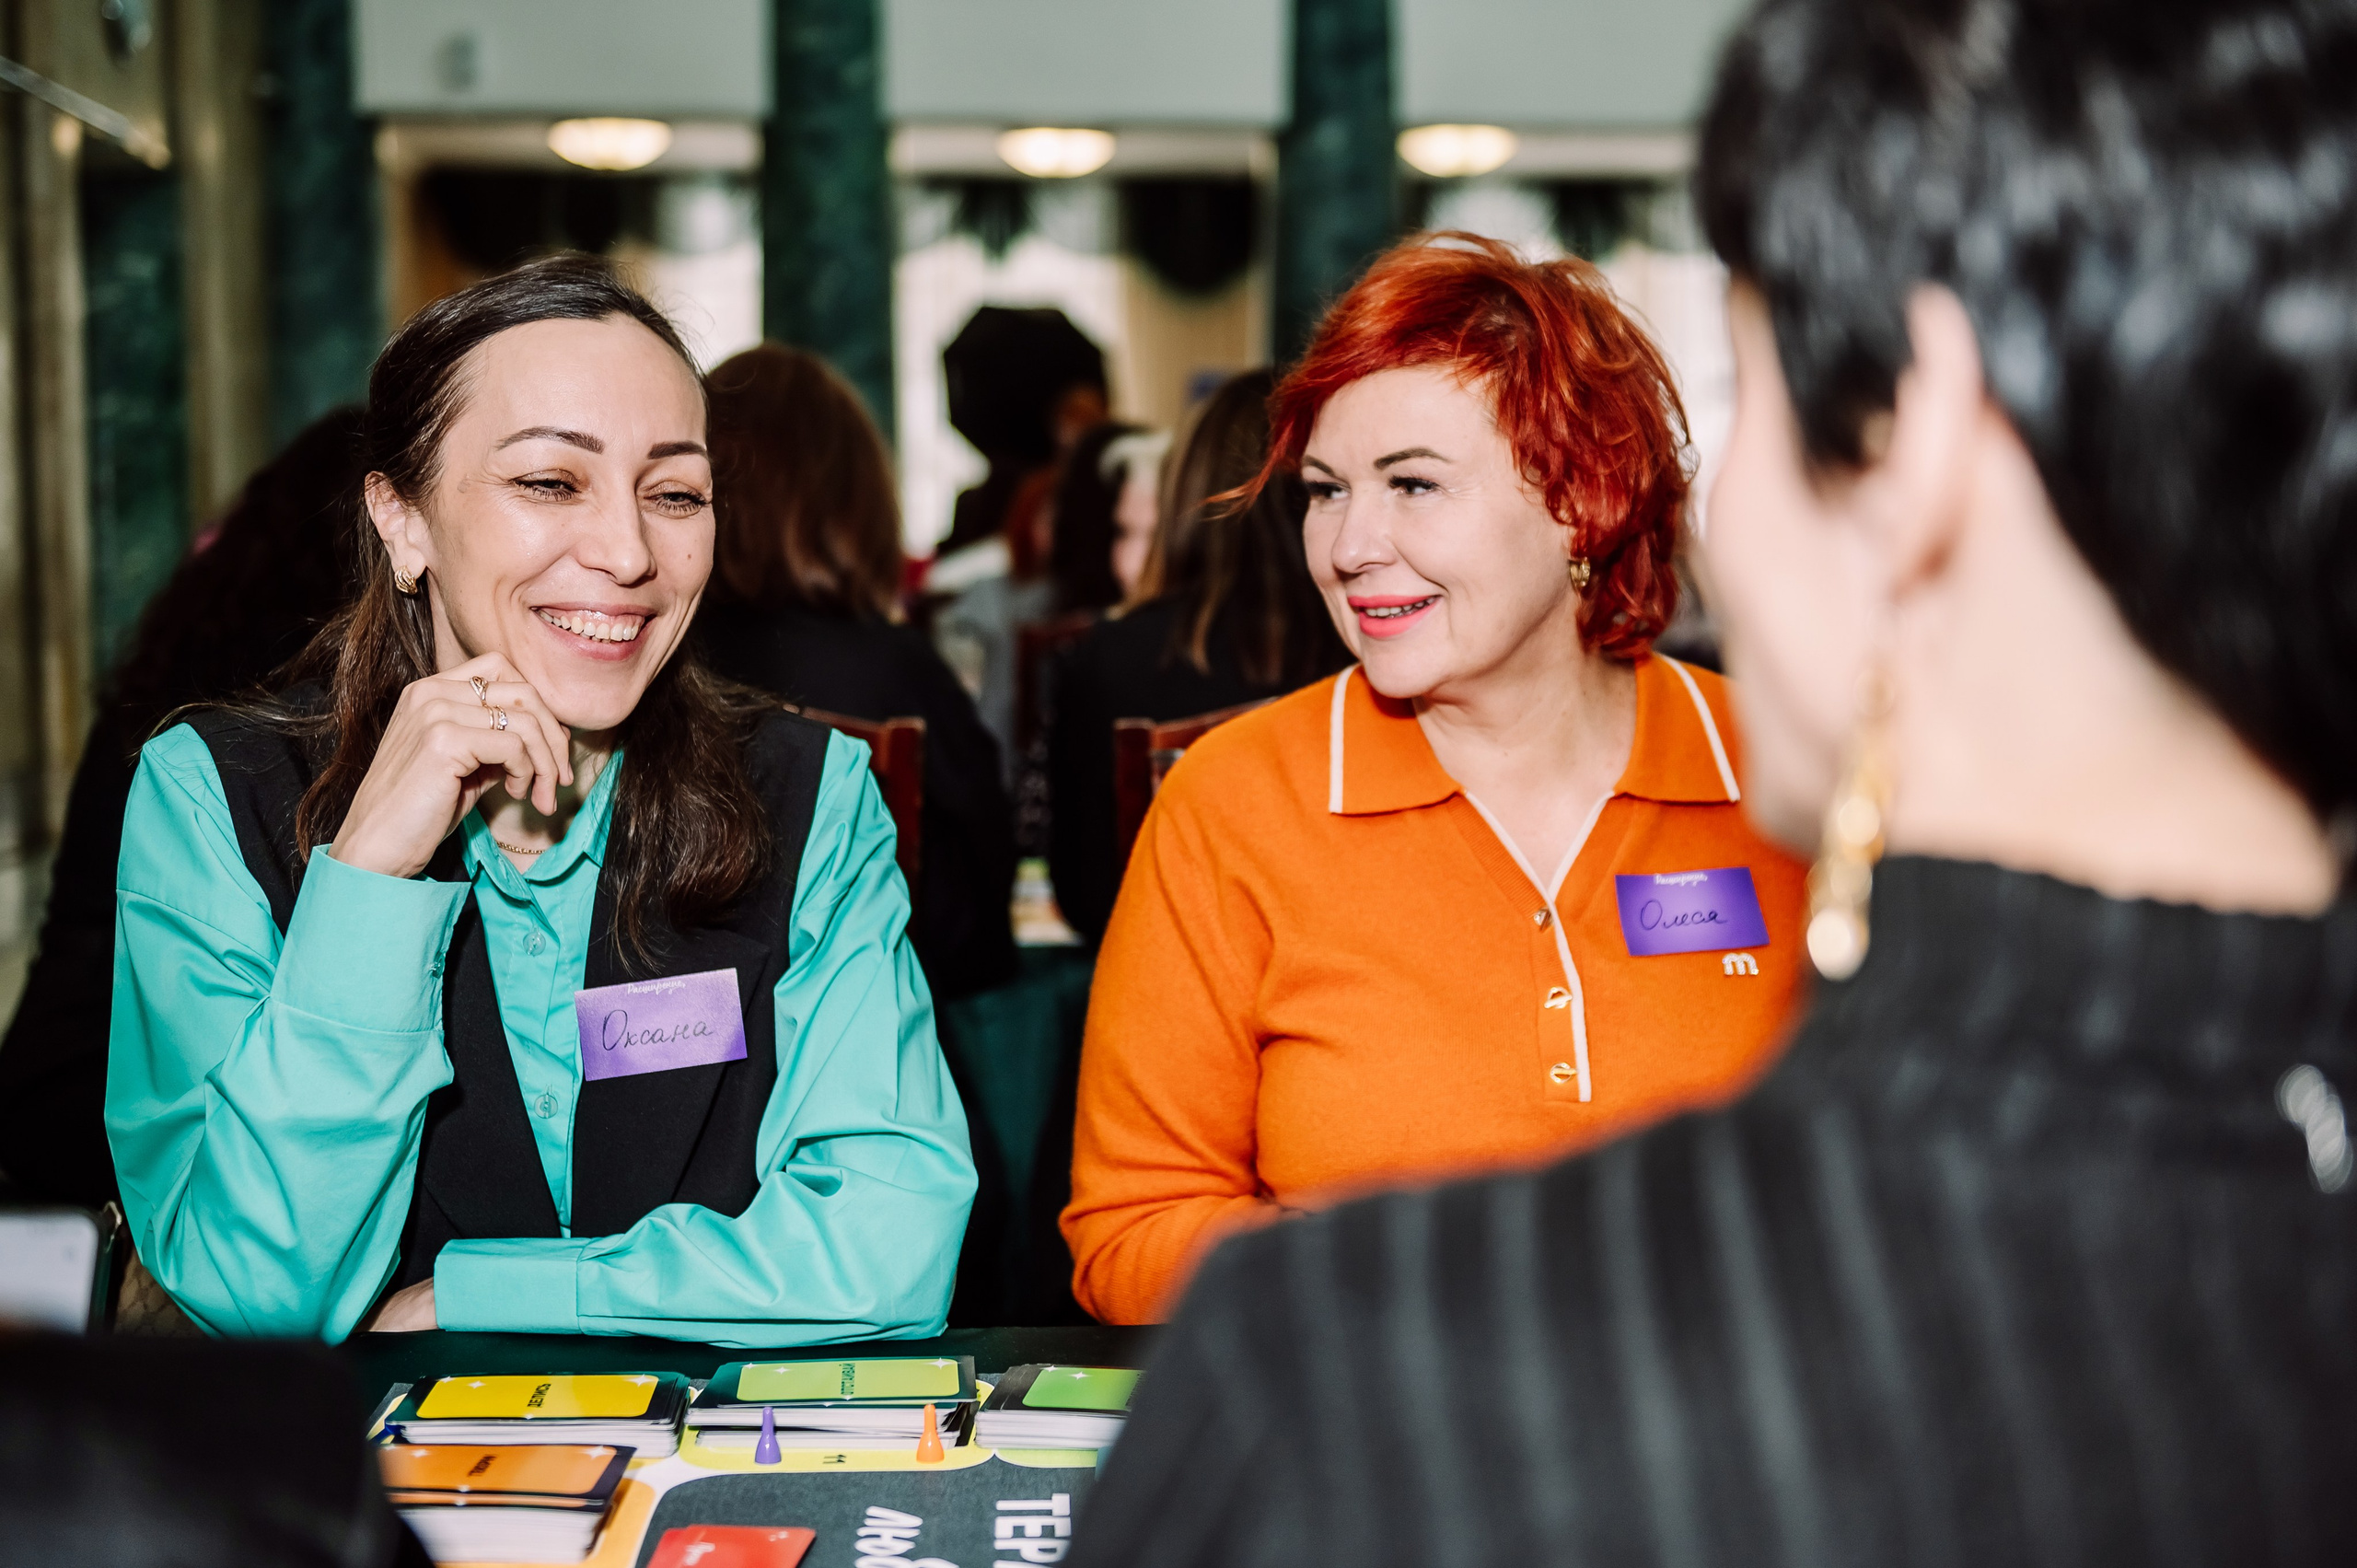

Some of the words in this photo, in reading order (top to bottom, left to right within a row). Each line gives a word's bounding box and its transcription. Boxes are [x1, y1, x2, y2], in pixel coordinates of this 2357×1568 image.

[1639, 899, 1728, 931] Олеся
[601, 1008, 714, 1051] Оксана
[526, 1383, 552, 1407] ДЕЛИСЬ
